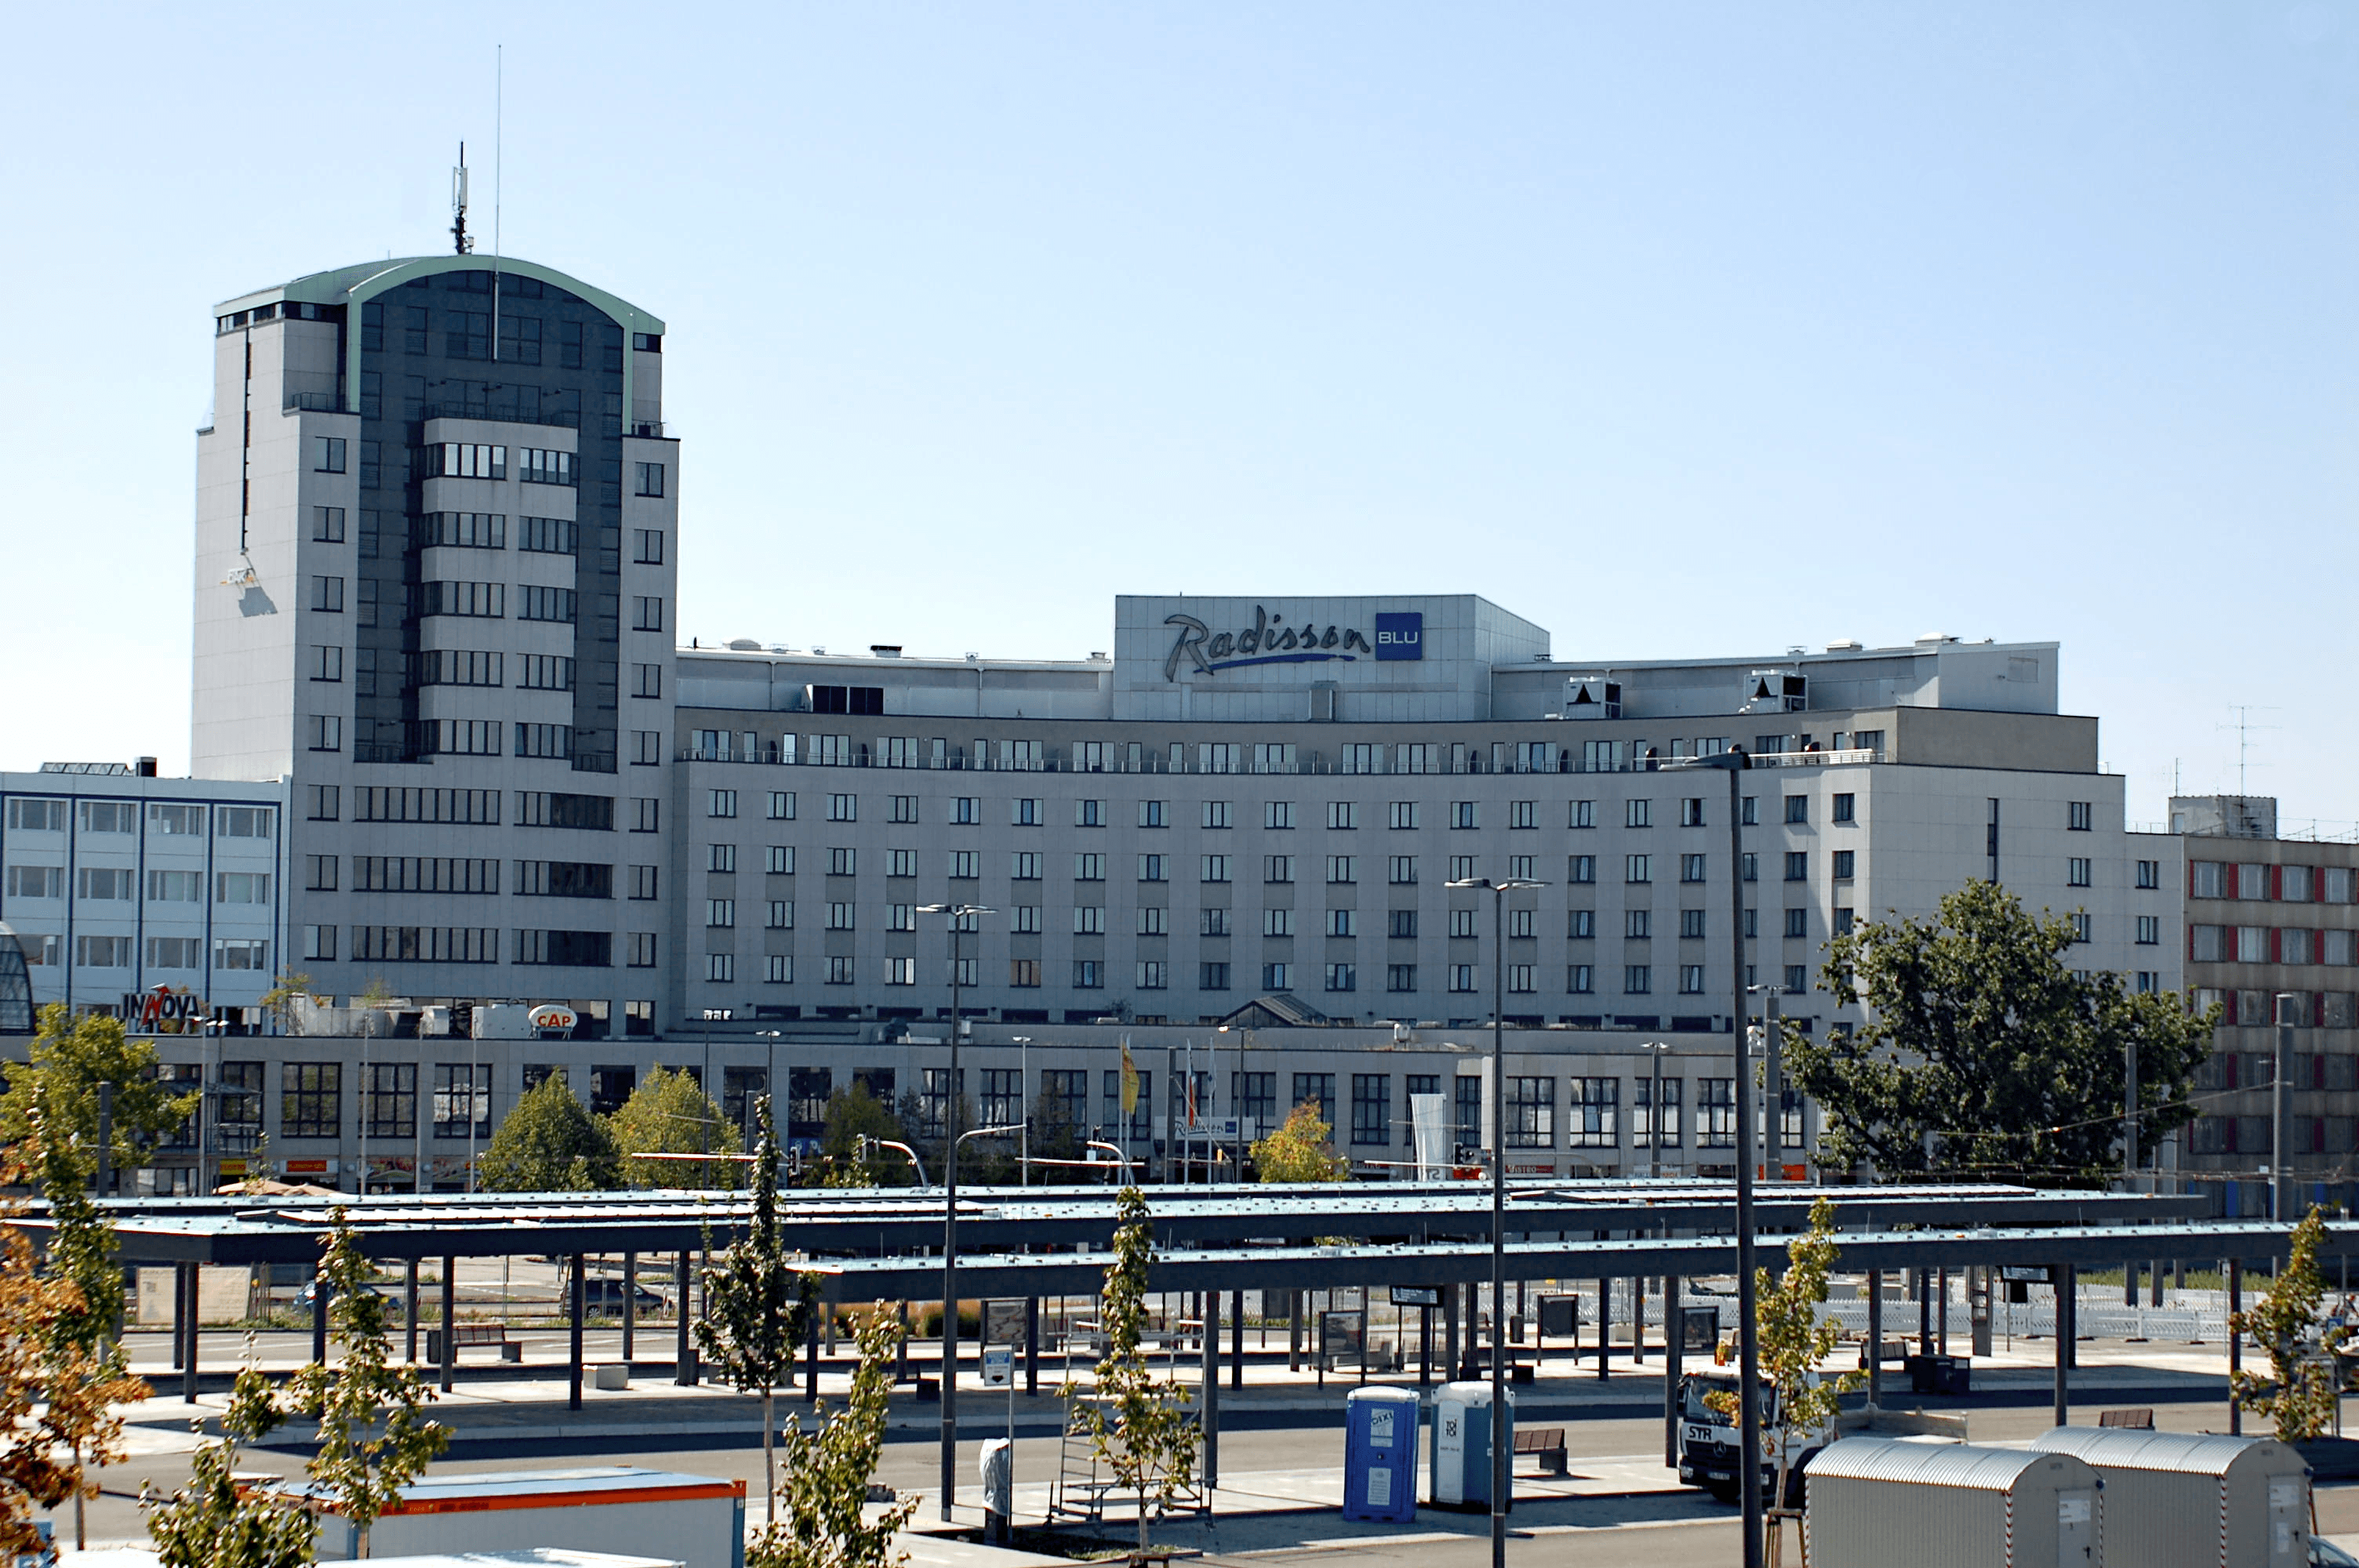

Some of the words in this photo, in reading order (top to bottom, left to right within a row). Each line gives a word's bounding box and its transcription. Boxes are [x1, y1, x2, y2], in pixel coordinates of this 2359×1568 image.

[1165, 604, 1371, 682] Radisson
[1378, 631, 1418, 644] BLU
[123, 987, 200, 1025] INNOVA
[537, 1014, 571, 1027] CAP
[1372, 1412, 1393, 1425] DIXI
[1688, 1425, 1713, 1441] STR
